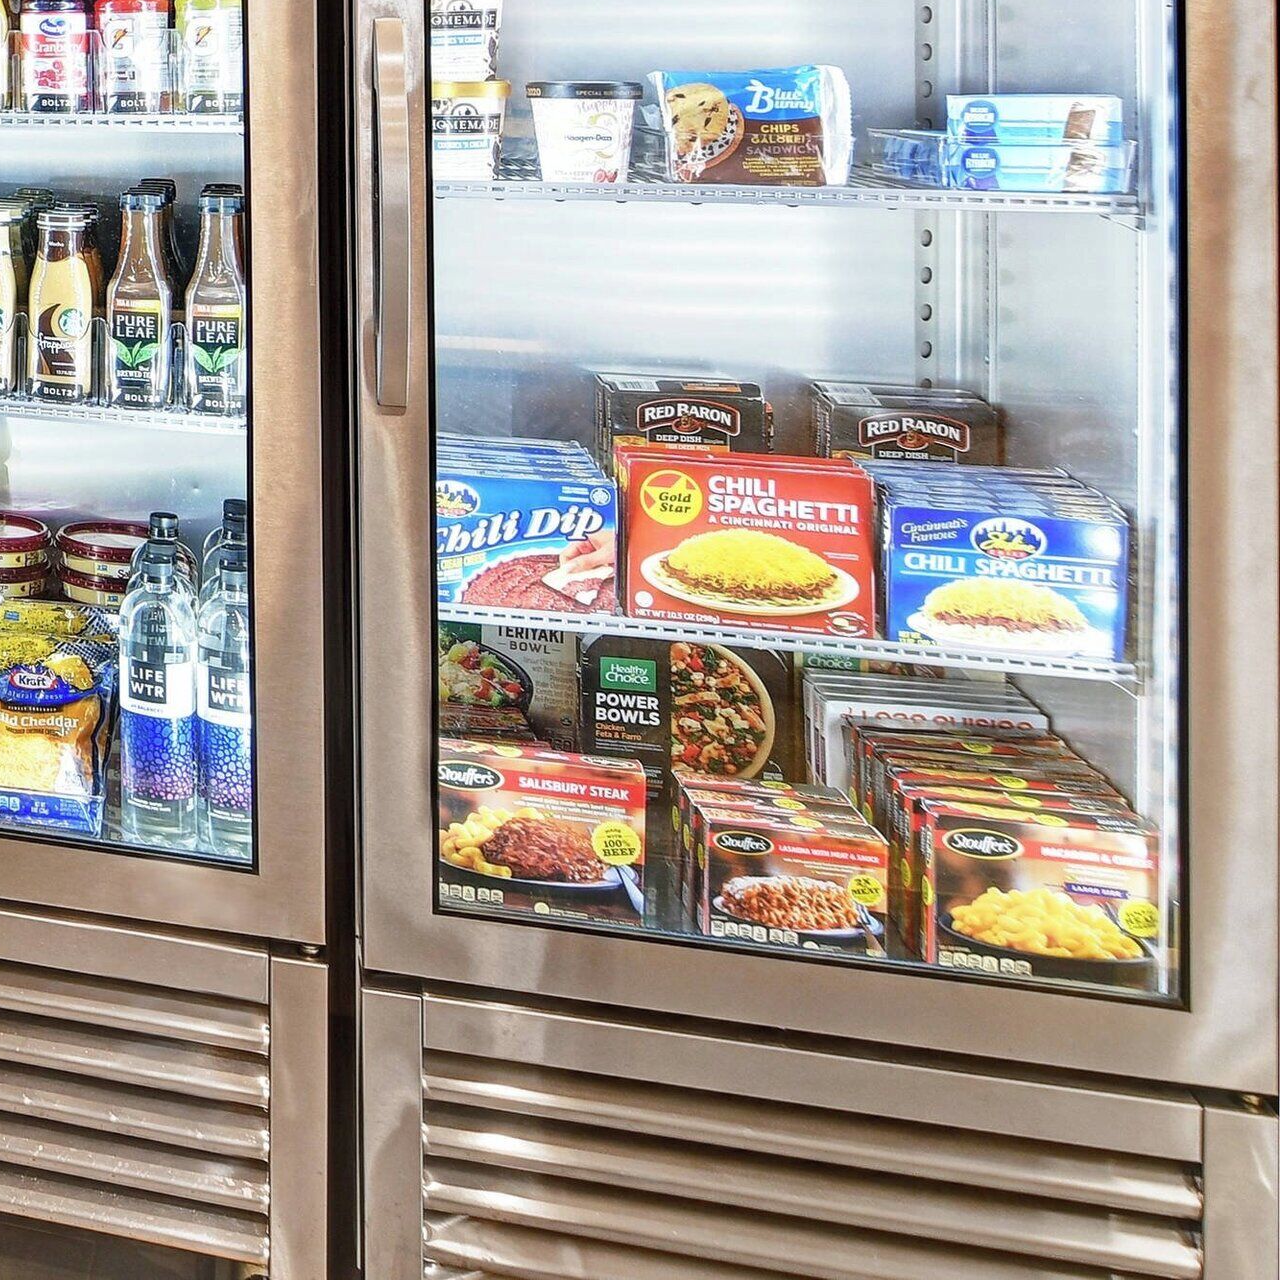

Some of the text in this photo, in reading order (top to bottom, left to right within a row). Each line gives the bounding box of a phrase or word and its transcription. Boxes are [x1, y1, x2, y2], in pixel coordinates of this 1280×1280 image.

[760, 124, 799, 134] CHIPS
[117, 315, 155, 328] PURE
[197, 320, 235, 333] PURE
[43, 387, 79, 397] BOLT24
[205, 399, 242, 409] BOLT24
[644, 403, 732, 426] RED BARON
[866, 418, 961, 442] RED BARON
[656, 434, 702, 444] DEEP DISH
[878, 450, 929, 460] DEEP DISH
[707, 474, 776, 498] CHILI
[658, 491, 691, 503] Gold
[659, 502, 692, 515] Star
[707, 495, 859, 524] SPAGHETTI
[523, 505, 603, 540] Dip
[721, 516, 859, 536] CINCINNATI ORIGINAL
[904, 552, 966, 574] CHILI
[509, 639, 551, 655] BOWL
[610, 663, 648, 677] Healthy
[807, 655, 853, 670] Choice
[18, 675, 47, 688] Kraft
[131, 667, 165, 683] LIFE
[605, 672, 650, 686] Choice
[131, 682, 165, 699] WTR
[595, 692, 660, 712] POWER
[595, 707, 661, 726] BOWLS
[595, 722, 626, 733] Chicken
[595, 730, 612, 740] Feta
[518, 775, 629, 801] SALISBURY STEAK
[720, 834, 768, 852] Stouffer's
[951, 832, 1014, 855] Stouffer's
[602, 846, 637, 858] BEEF
